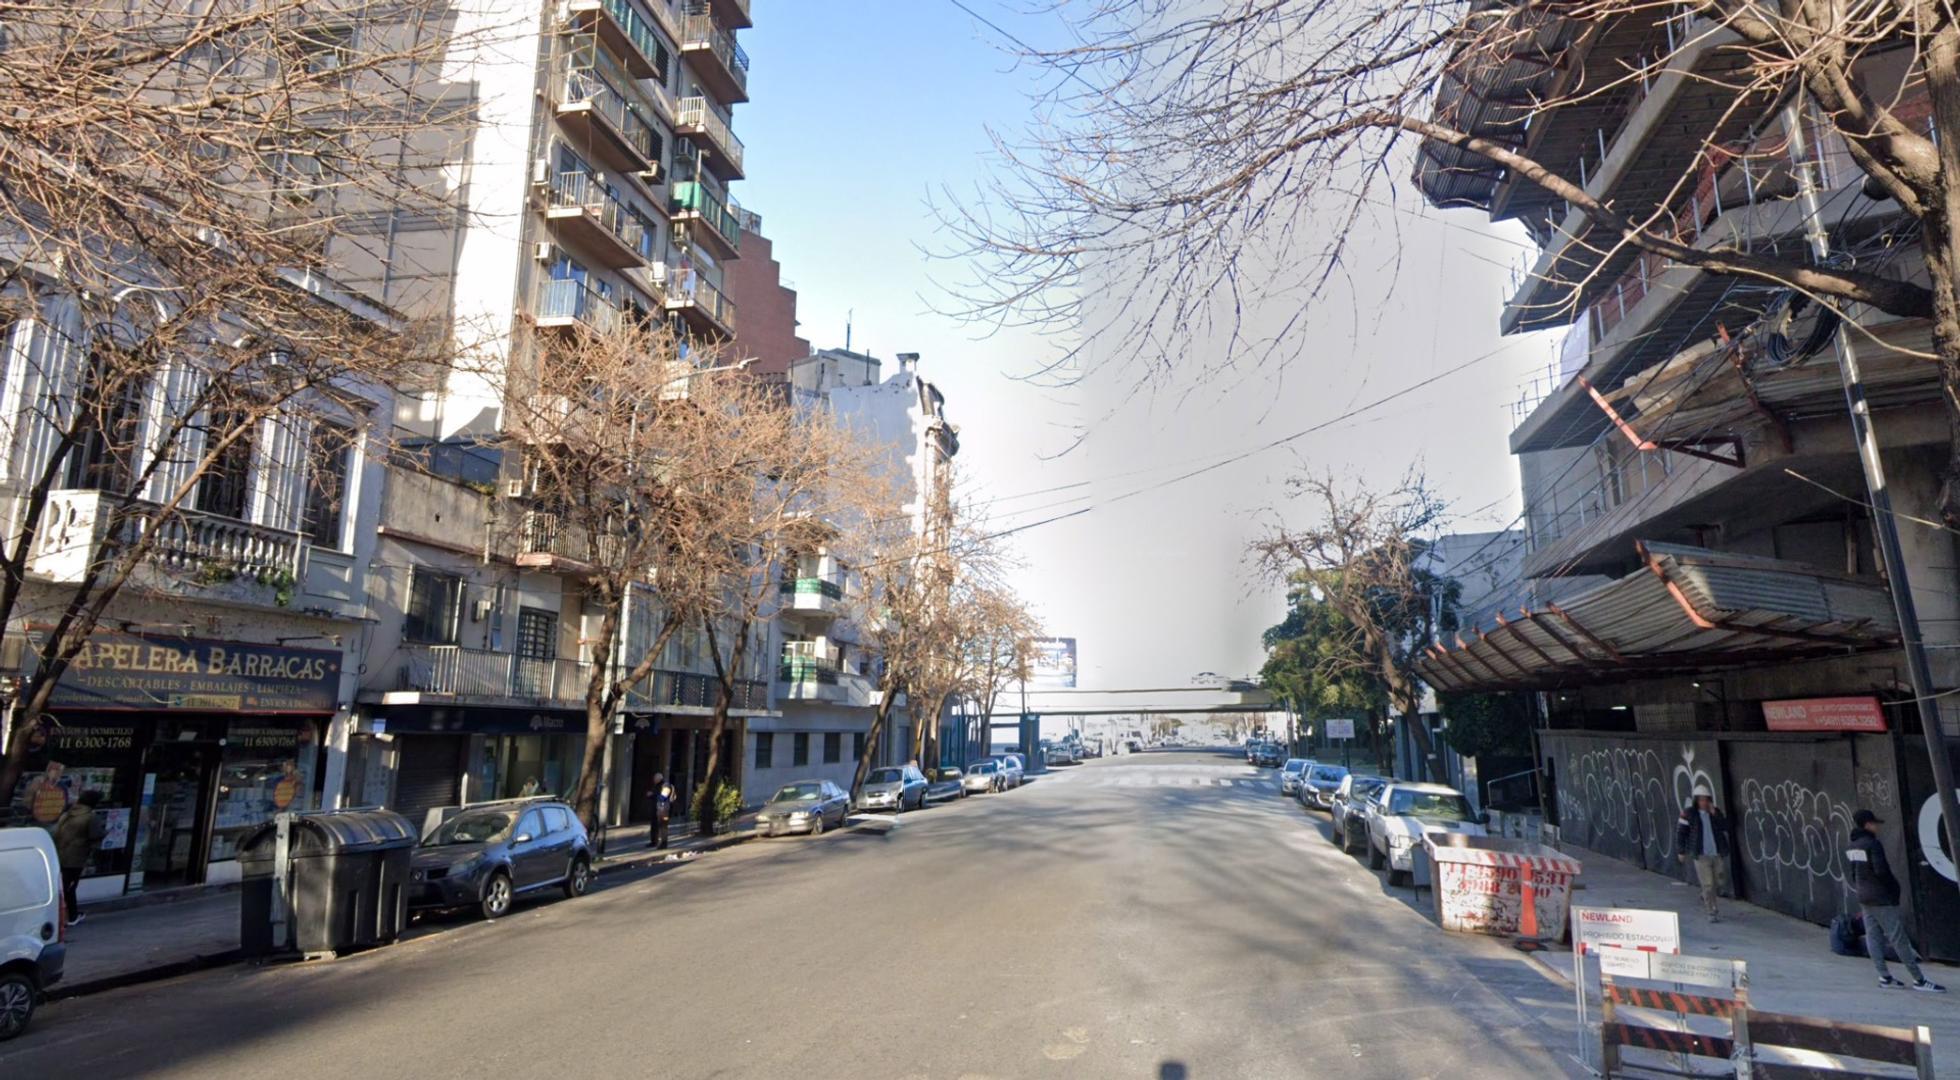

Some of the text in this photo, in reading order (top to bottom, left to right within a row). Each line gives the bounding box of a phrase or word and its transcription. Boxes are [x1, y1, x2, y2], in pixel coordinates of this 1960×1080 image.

[71, 640, 326, 680] APELERA BARRACAS
[87, 676, 181, 690] DESCARTABLES
[190, 681, 250, 694] EMBALAJES
[59, 737, 133, 749] 11 6300-1768
[1582, 912, 1633, 923] NEWLAND
